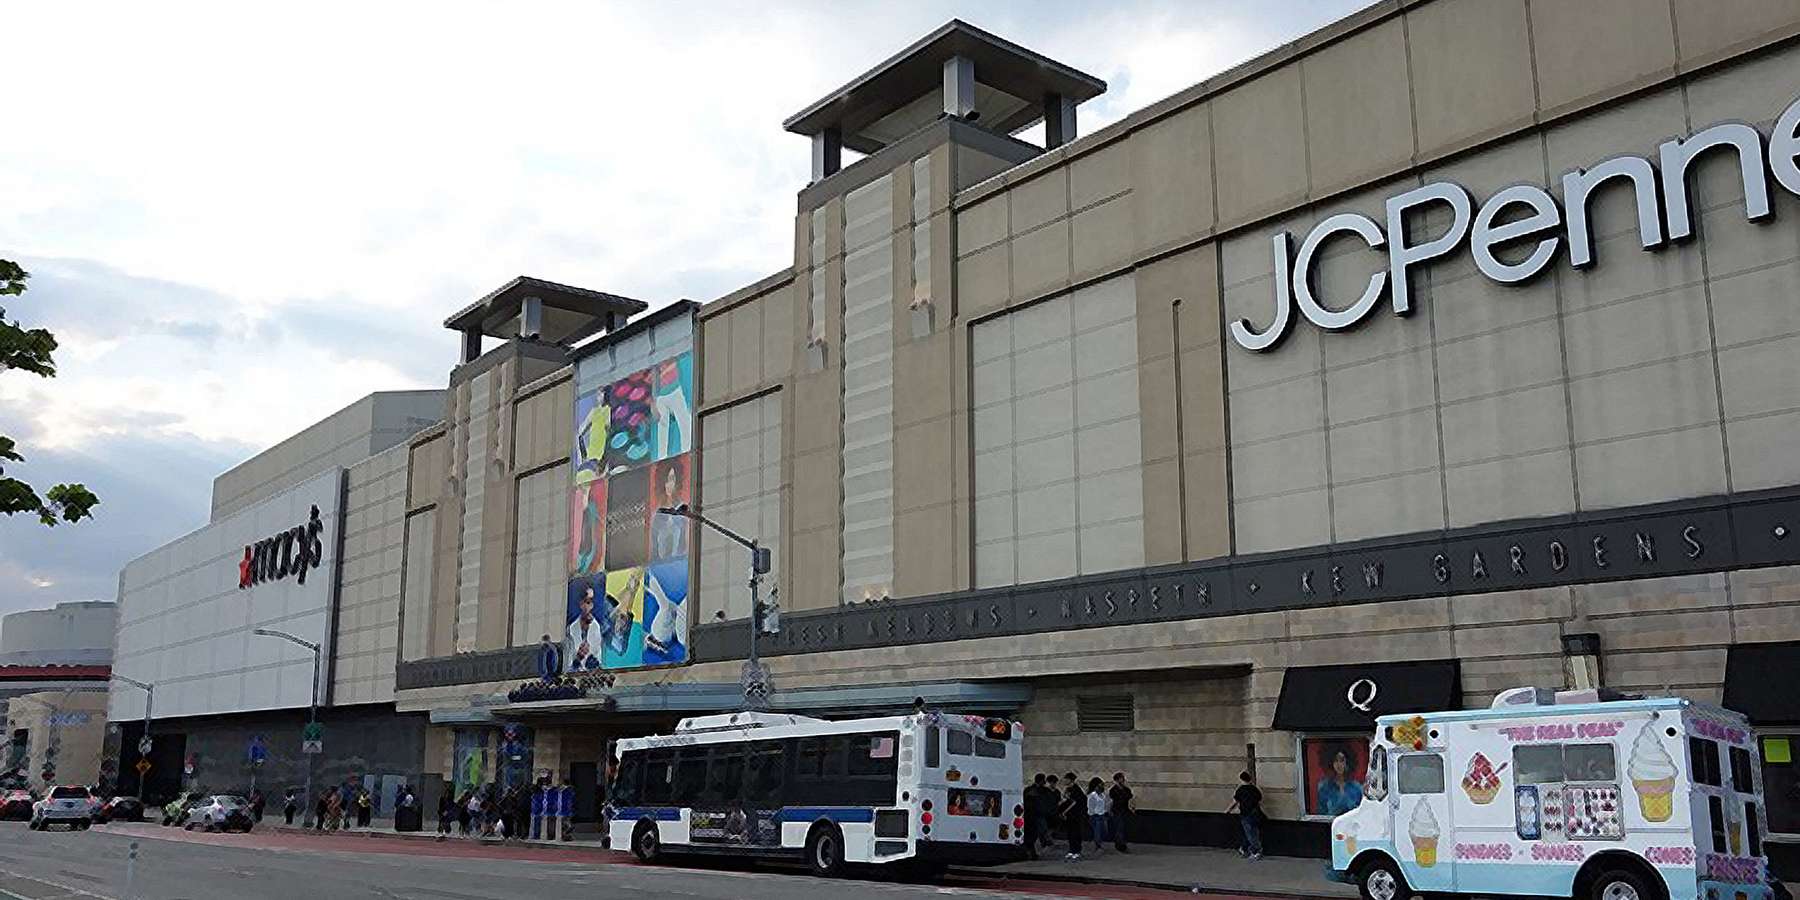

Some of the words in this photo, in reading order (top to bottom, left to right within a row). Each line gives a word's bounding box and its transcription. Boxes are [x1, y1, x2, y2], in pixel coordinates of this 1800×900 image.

[1300, 560, 1384, 597] KEW
[1431, 525, 1704, 584] GARDENS
[1347, 679, 1377, 711] Q
